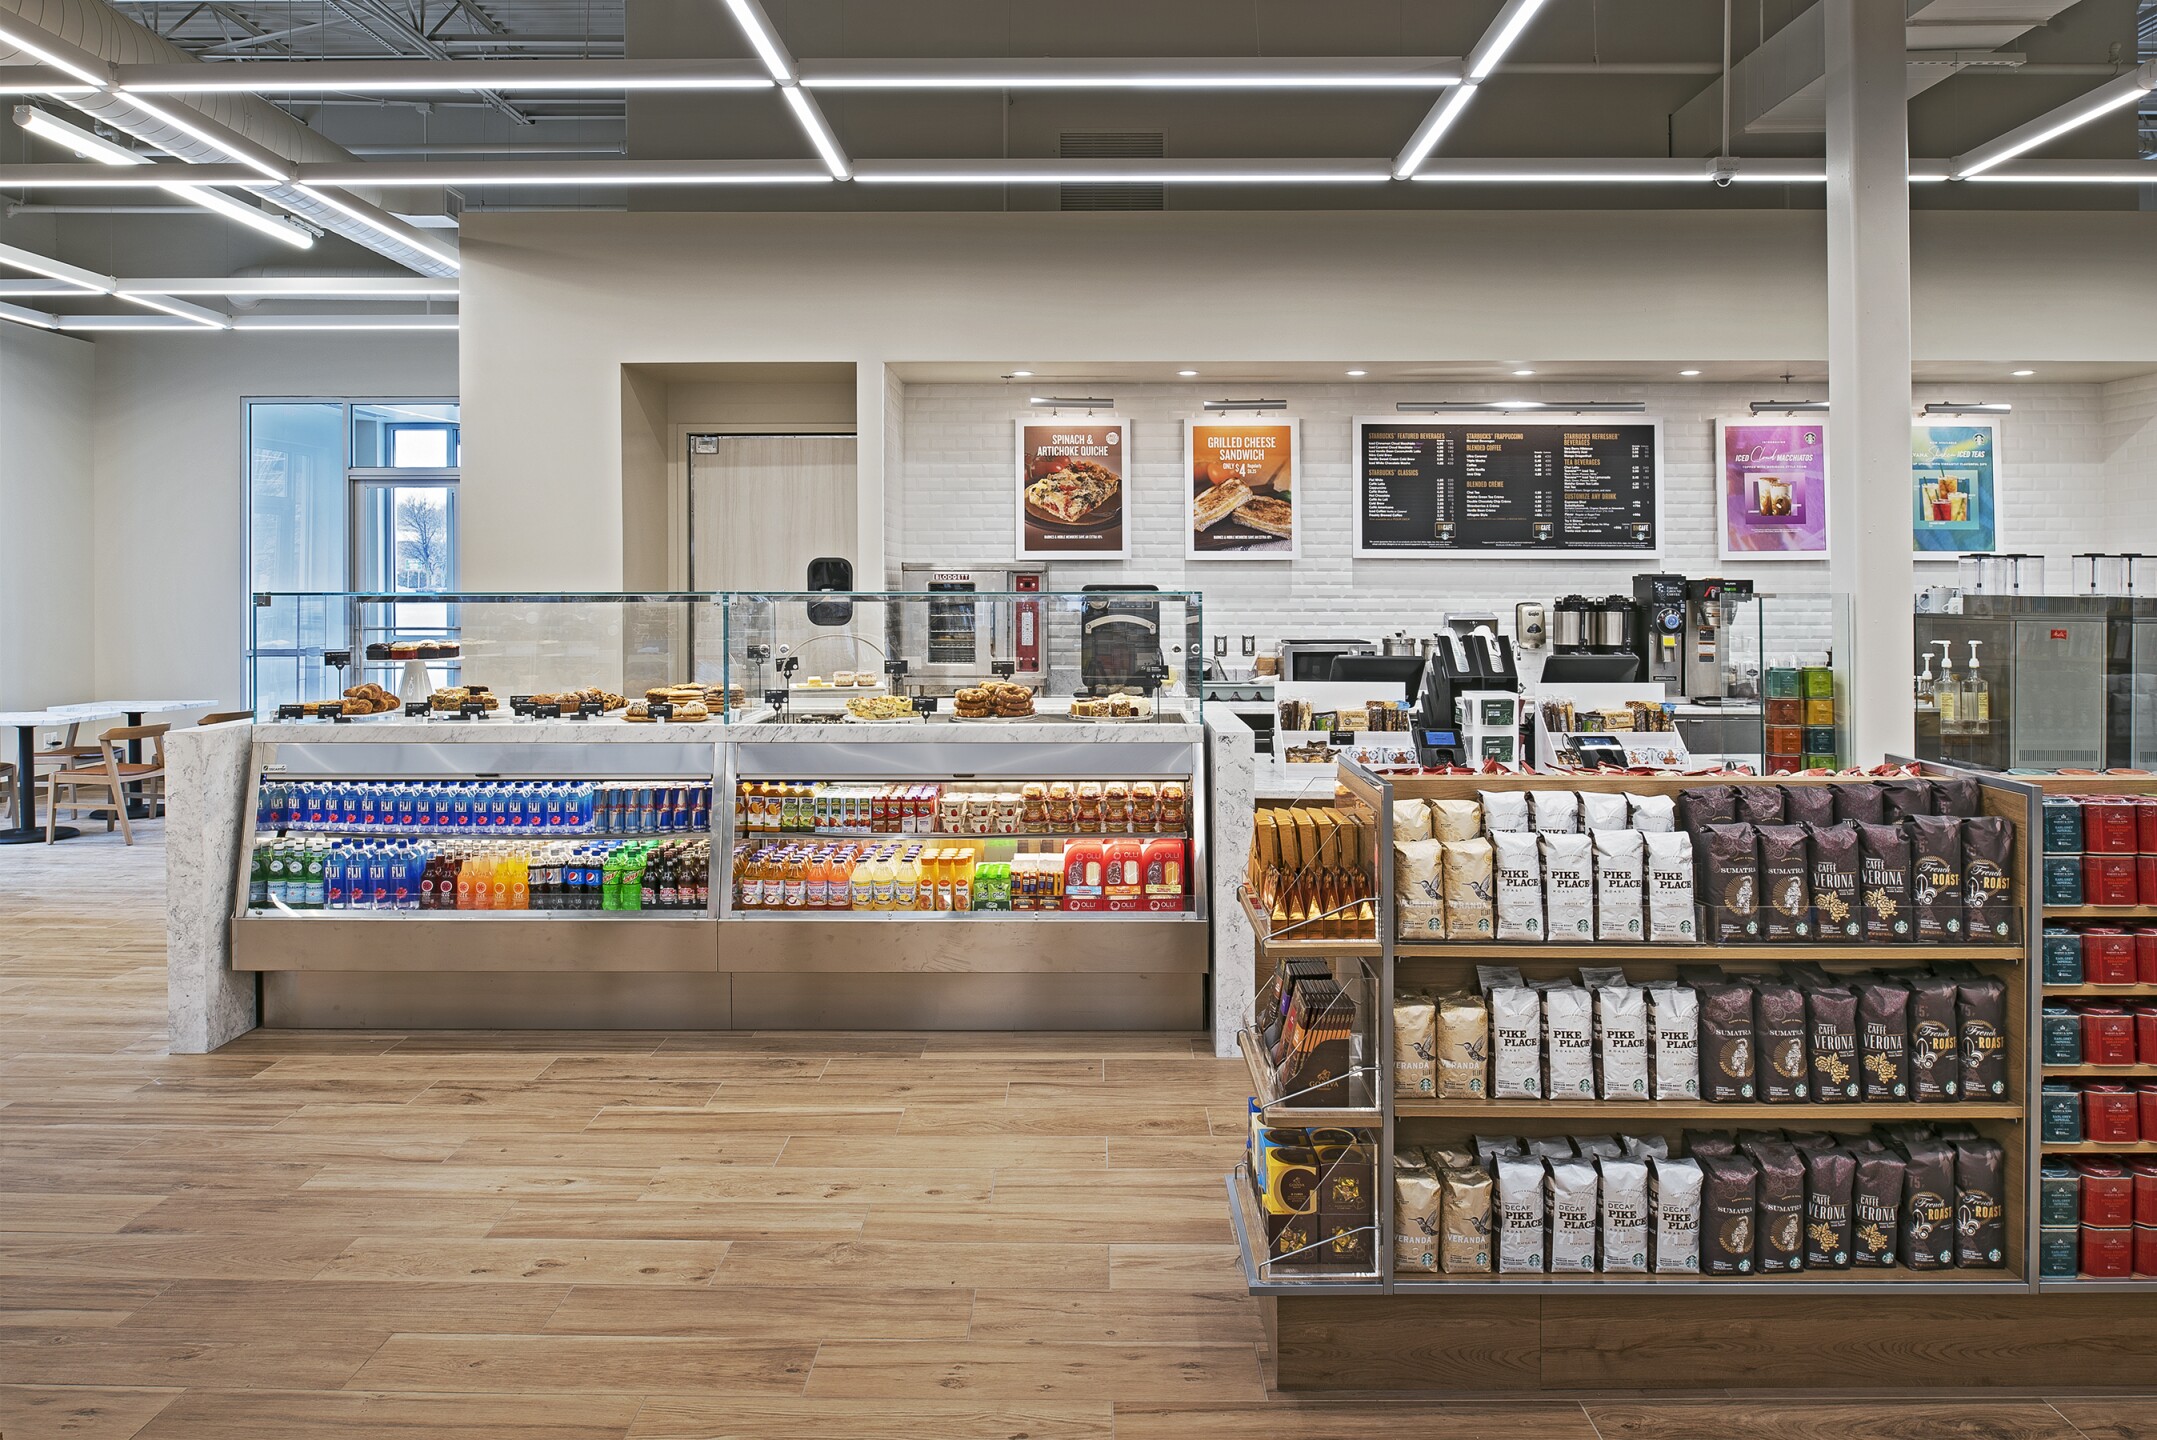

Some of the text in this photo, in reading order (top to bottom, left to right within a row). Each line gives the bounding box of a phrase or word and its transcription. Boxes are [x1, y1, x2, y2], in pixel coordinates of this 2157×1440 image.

[1052, 434, 1094, 444] SPINACH &
[1208, 436, 1276, 448] GRILLED CHEESE
[1038, 446, 1108, 456] ARTICHOKE QUICHE
[1220, 449, 1264, 460] SANDWICH
[289, 798, 299, 808] FIJI
[308, 799, 320, 810] FIJI
[326, 799, 337, 810] FIJI
[344, 800, 355, 810] FIJI
[362, 800, 373, 811] FIJI
[381, 801, 393, 812] FIJI
[400, 801, 411, 812] FIJI
[418, 801, 429, 812] FIJI
[436, 802, 448, 812] FIJI
[455, 802, 466, 812] FIJI
[474, 802, 486, 812] FIJI
[492, 802, 504, 812] FIJI
[509, 802, 520, 812] FIJI
[528, 802, 540, 813] FIJI
[548, 802, 559, 812] FIJI
[566, 802, 578, 812] FIJI
[325, 867, 340, 878] FIJI
[347, 867, 361, 878] FIJI
[370, 867, 384, 878] FIJI
[391, 866, 406, 878] FIJI
[1920, 862, 1950, 873] French
[1971, 865, 2002, 876] French
[1501, 870, 1528, 878] PIKE
[1551, 871, 1579, 879] PIKE
[1603, 871, 1631, 879] PIKE
[1654, 872, 1682, 880] PIKE
[1862, 870, 1902, 885] VERONA
[1932, 873, 1959, 885] ROAST
[1814, 873, 1854, 888] VERONA
[1984, 877, 2010, 889] ROAST
[1498, 1029, 1526, 1038] PIKE
[1553, 1031, 1581, 1039] PIKE
[1607, 1031, 1635, 1039] PIKE
[1661, 1032, 1688, 1040] PIKE
[1920, 1026, 1950, 1037] French
[1966, 1025, 1996, 1037] French
[1504, 1038, 1537, 1046] PLACE
[1559, 1039, 1590, 1047] PLACE
[1612, 1039, 1644, 1047] PLACE
[1666, 1040, 1697, 1048] PLACE
[1814, 1035, 1854, 1050] VERONA
[1864, 1034, 1902, 1050] VERONA
[1933, 1037, 1956, 1050] ROAST
[1979, 1036, 2004, 1049] ROAST
[1915, 1197, 1945, 1208] French
[1963, 1195, 1993, 1206] French
[1505, 1211, 1533, 1220] PIKE
[1608, 1210, 1636, 1218] PIKE
[1809, 1202, 1845, 1219] VERONA
[1856, 1204, 1895, 1221] VERONA
[1928, 1206, 1952, 1220] ROAST
[1976, 1205, 2001, 1218] ROAST
[1559, 1212, 1587, 1220] PIKE
[1663, 1213, 1691, 1222] PIKE
[1510, 1220, 1542, 1228] PLACE
[1564, 1220, 1595, 1229] PLACE
[1614, 1218, 1647, 1227] PLACE
[1668, 1221, 1698, 1230] PLACE
[1448, 1234, 1485, 1243] VERANDA
